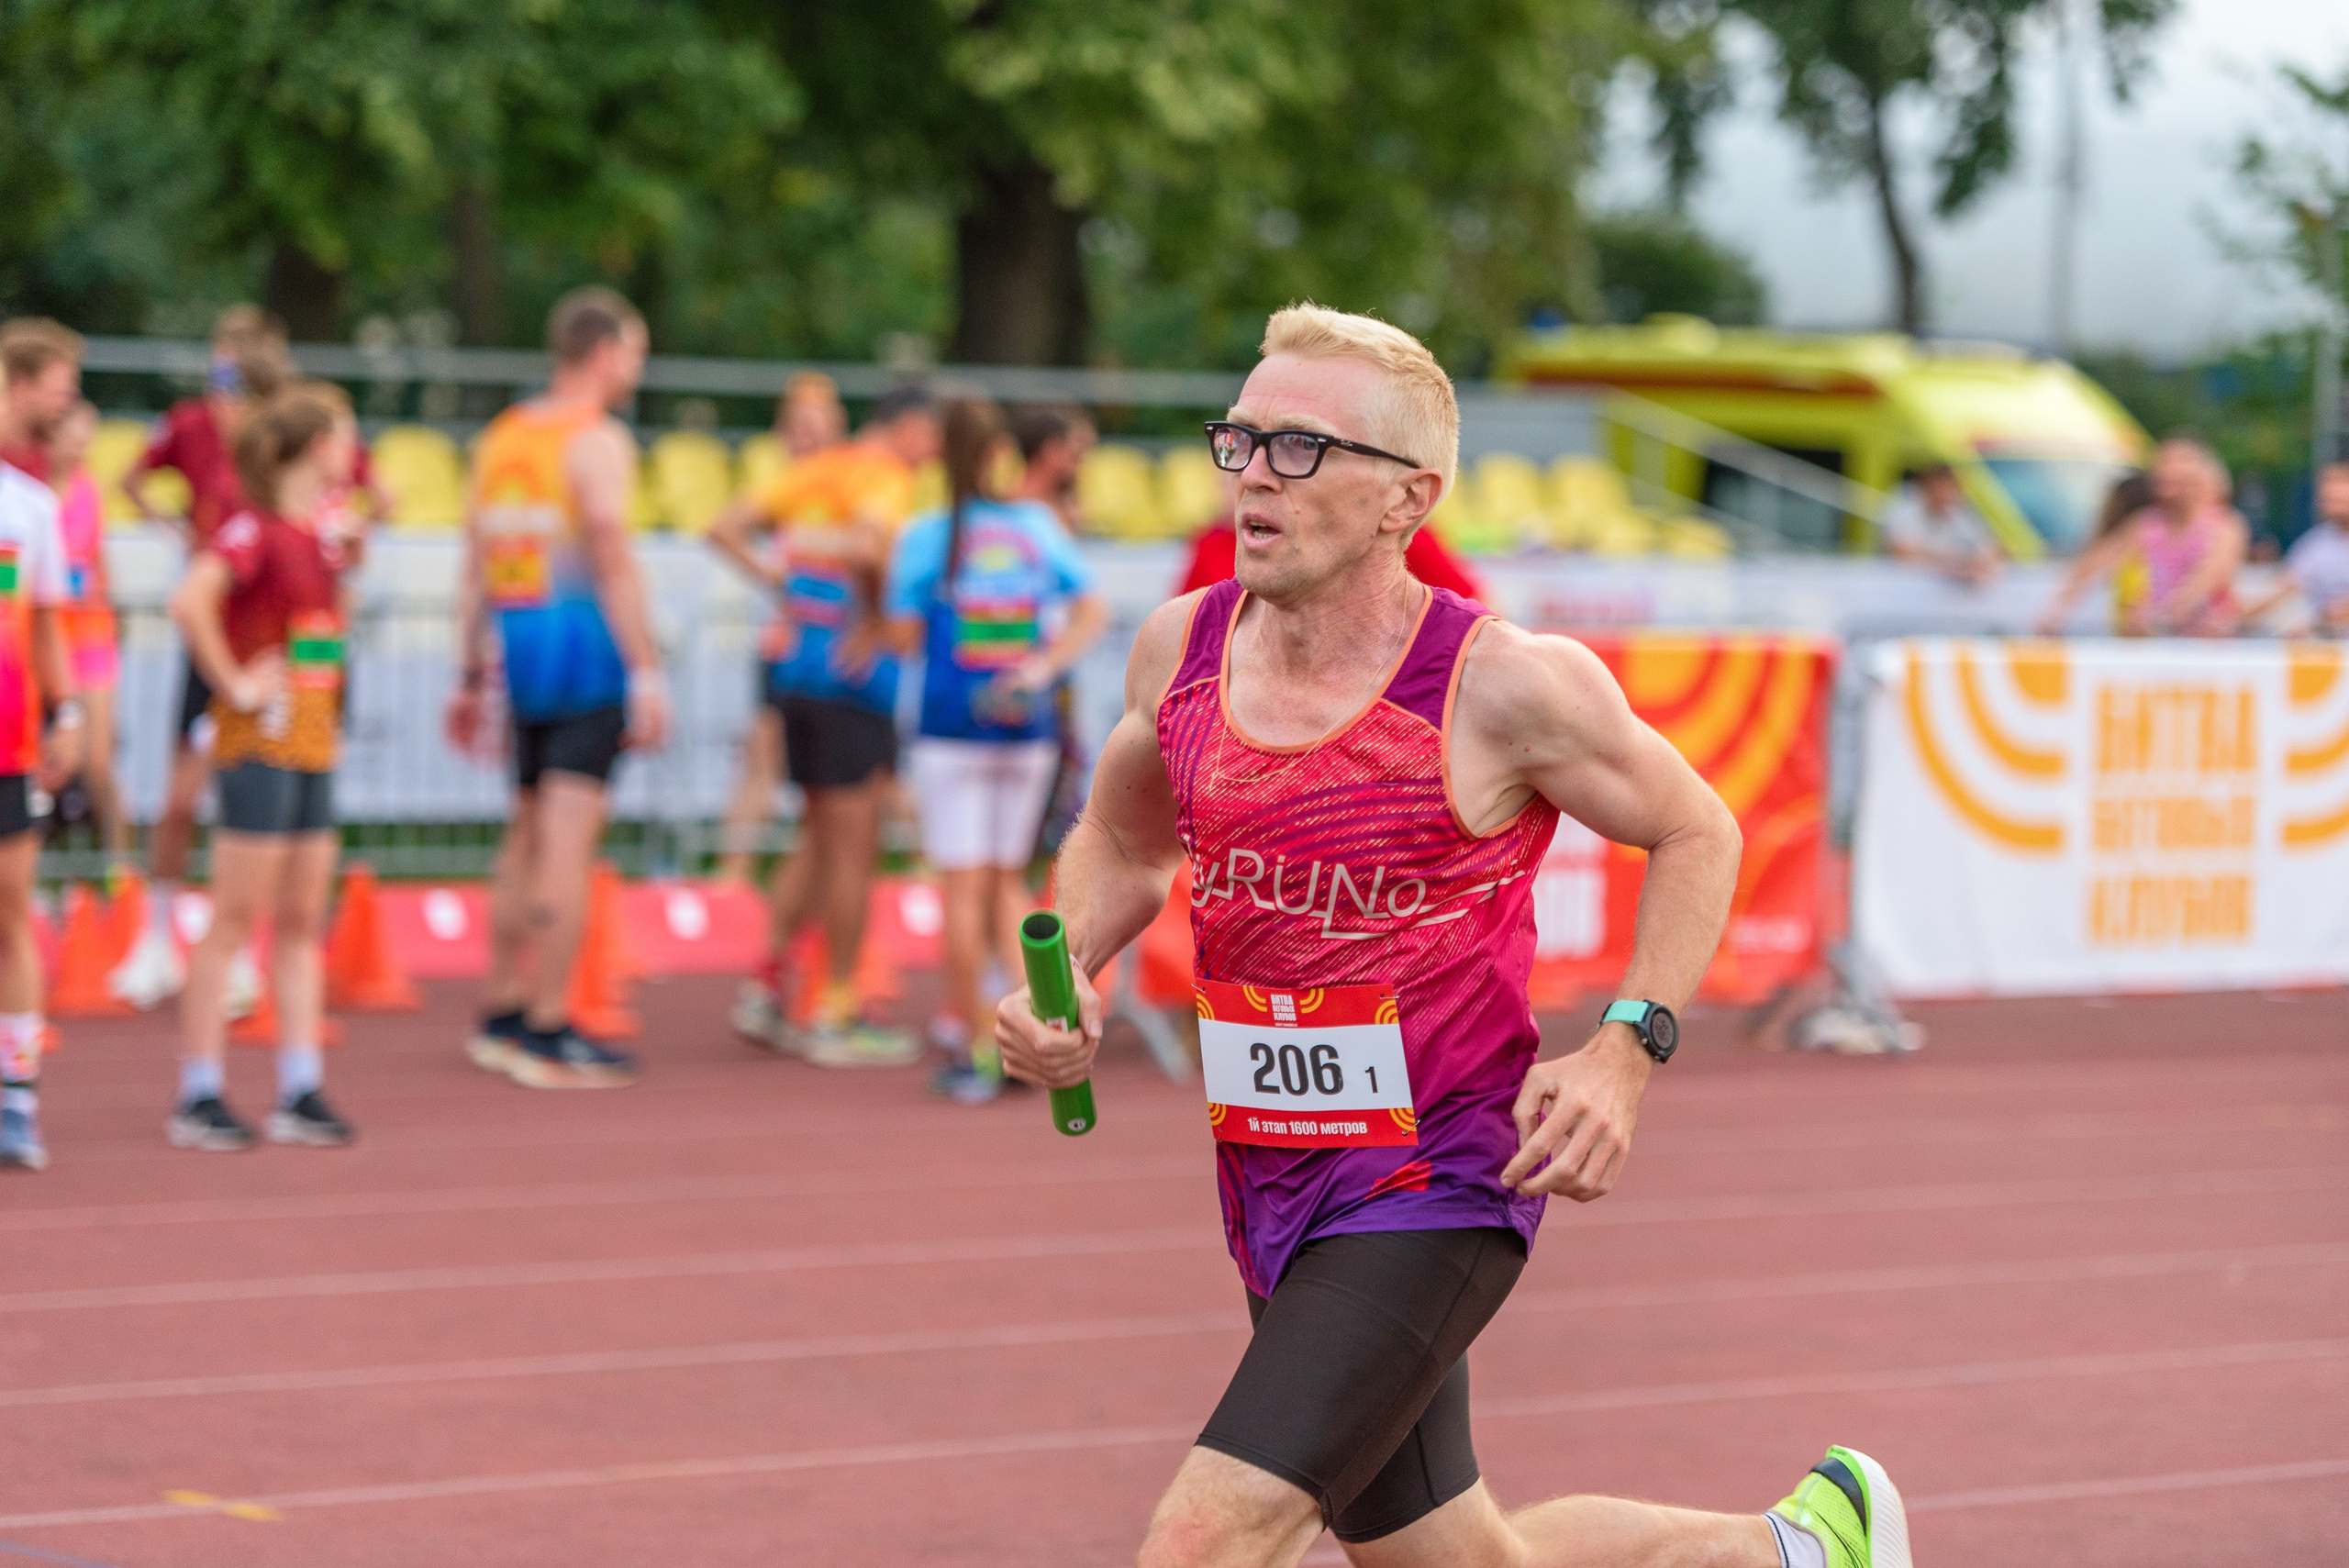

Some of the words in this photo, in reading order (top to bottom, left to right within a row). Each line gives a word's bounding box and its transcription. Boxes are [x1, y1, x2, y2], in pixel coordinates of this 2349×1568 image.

[1271, 994, 1294, 1006] БИТВА
[1250, 1042, 1344, 1096] 206
[1364, 1066, 1378, 1094] 1
[1247, 1117, 1260, 1132] 1й
[1261, 1120, 1287, 1135] этап
[1289, 1121, 1318, 1135] 1600
[1319, 1121, 1368, 1137] метров
